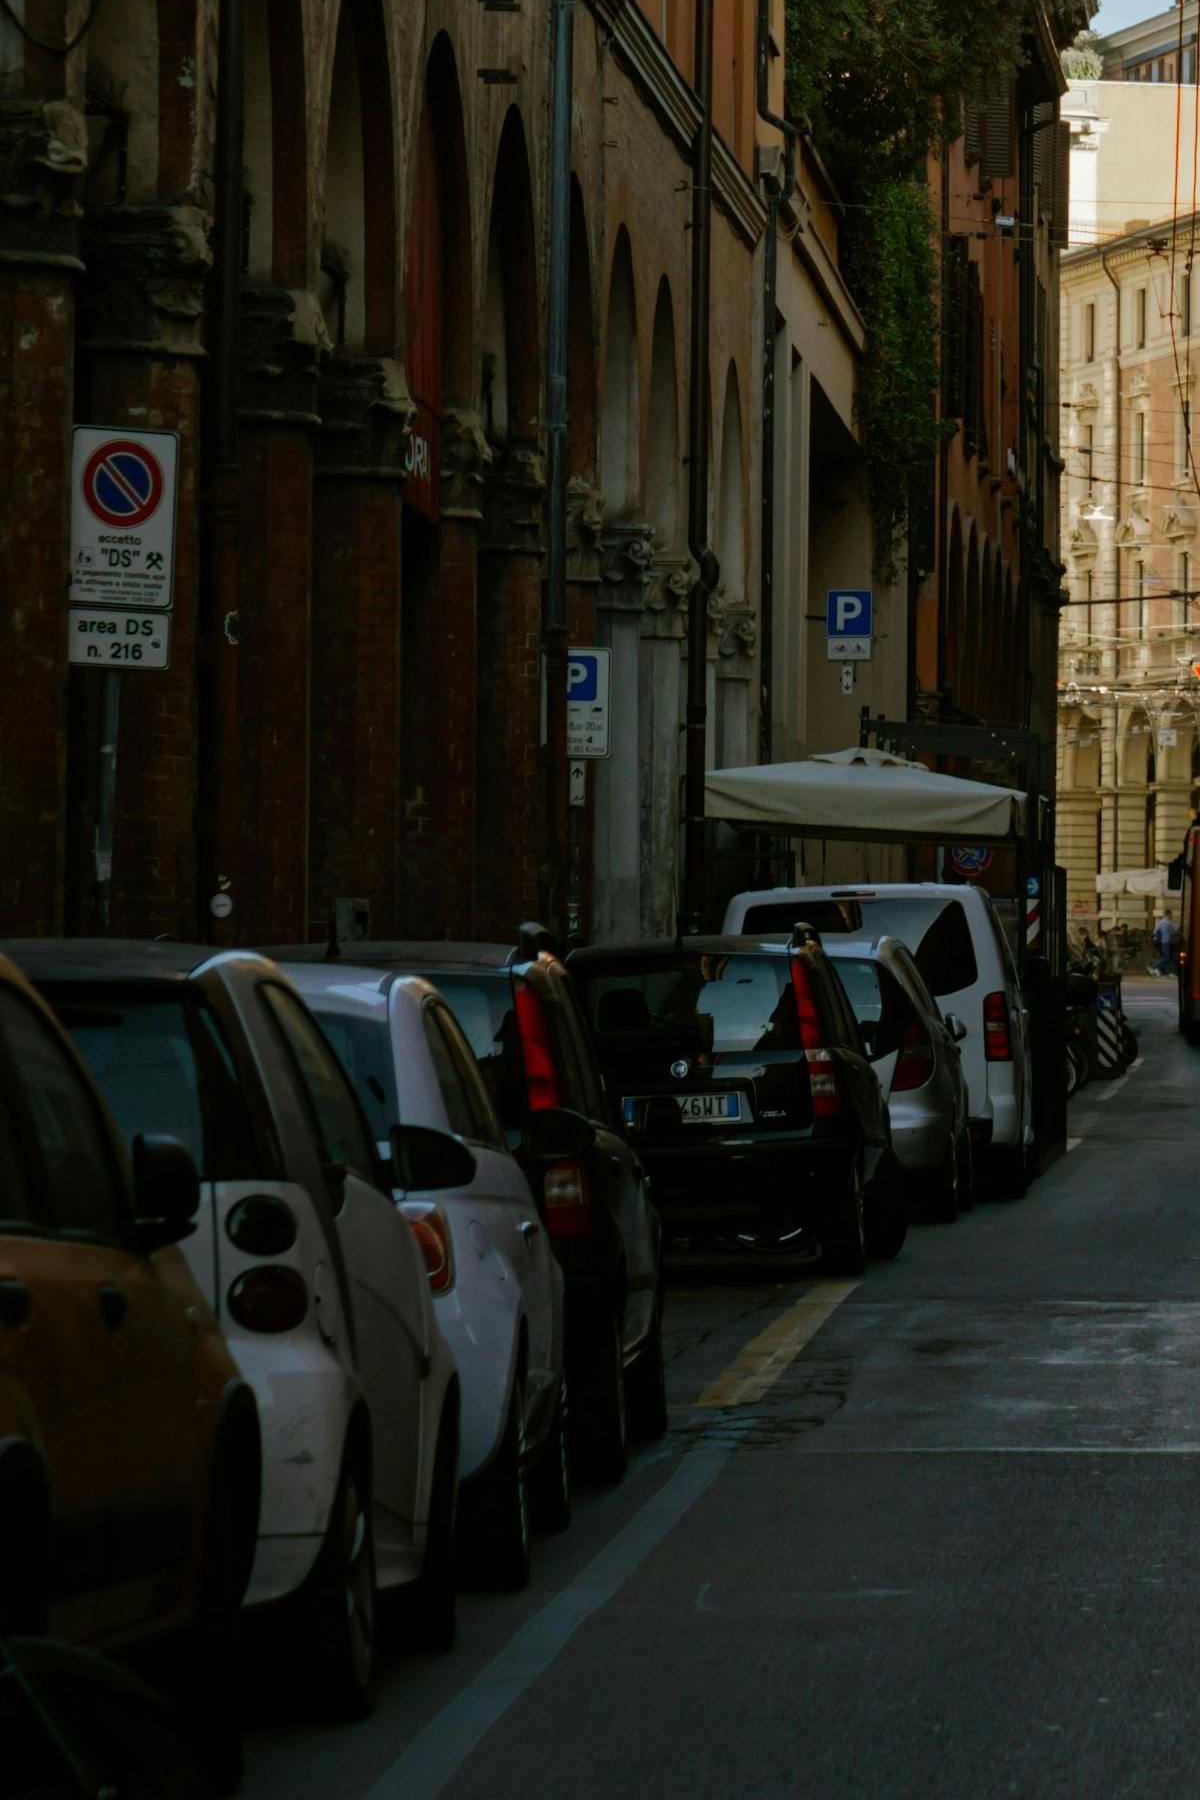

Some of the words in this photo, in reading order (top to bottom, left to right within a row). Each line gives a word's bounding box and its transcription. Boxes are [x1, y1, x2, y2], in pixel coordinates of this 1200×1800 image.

[98, 535, 142, 546] eccetto
[100, 548, 141, 568] "DS"
[836, 595, 863, 631] P
[78, 620, 118, 634] area
[126, 619, 154, 636] DS
[87, 644, 102, 658] n.
[110, 642, 142, 660] 216
[567, 662, 588, 694] P
[680, 1096, 725, 1117] 46WT
